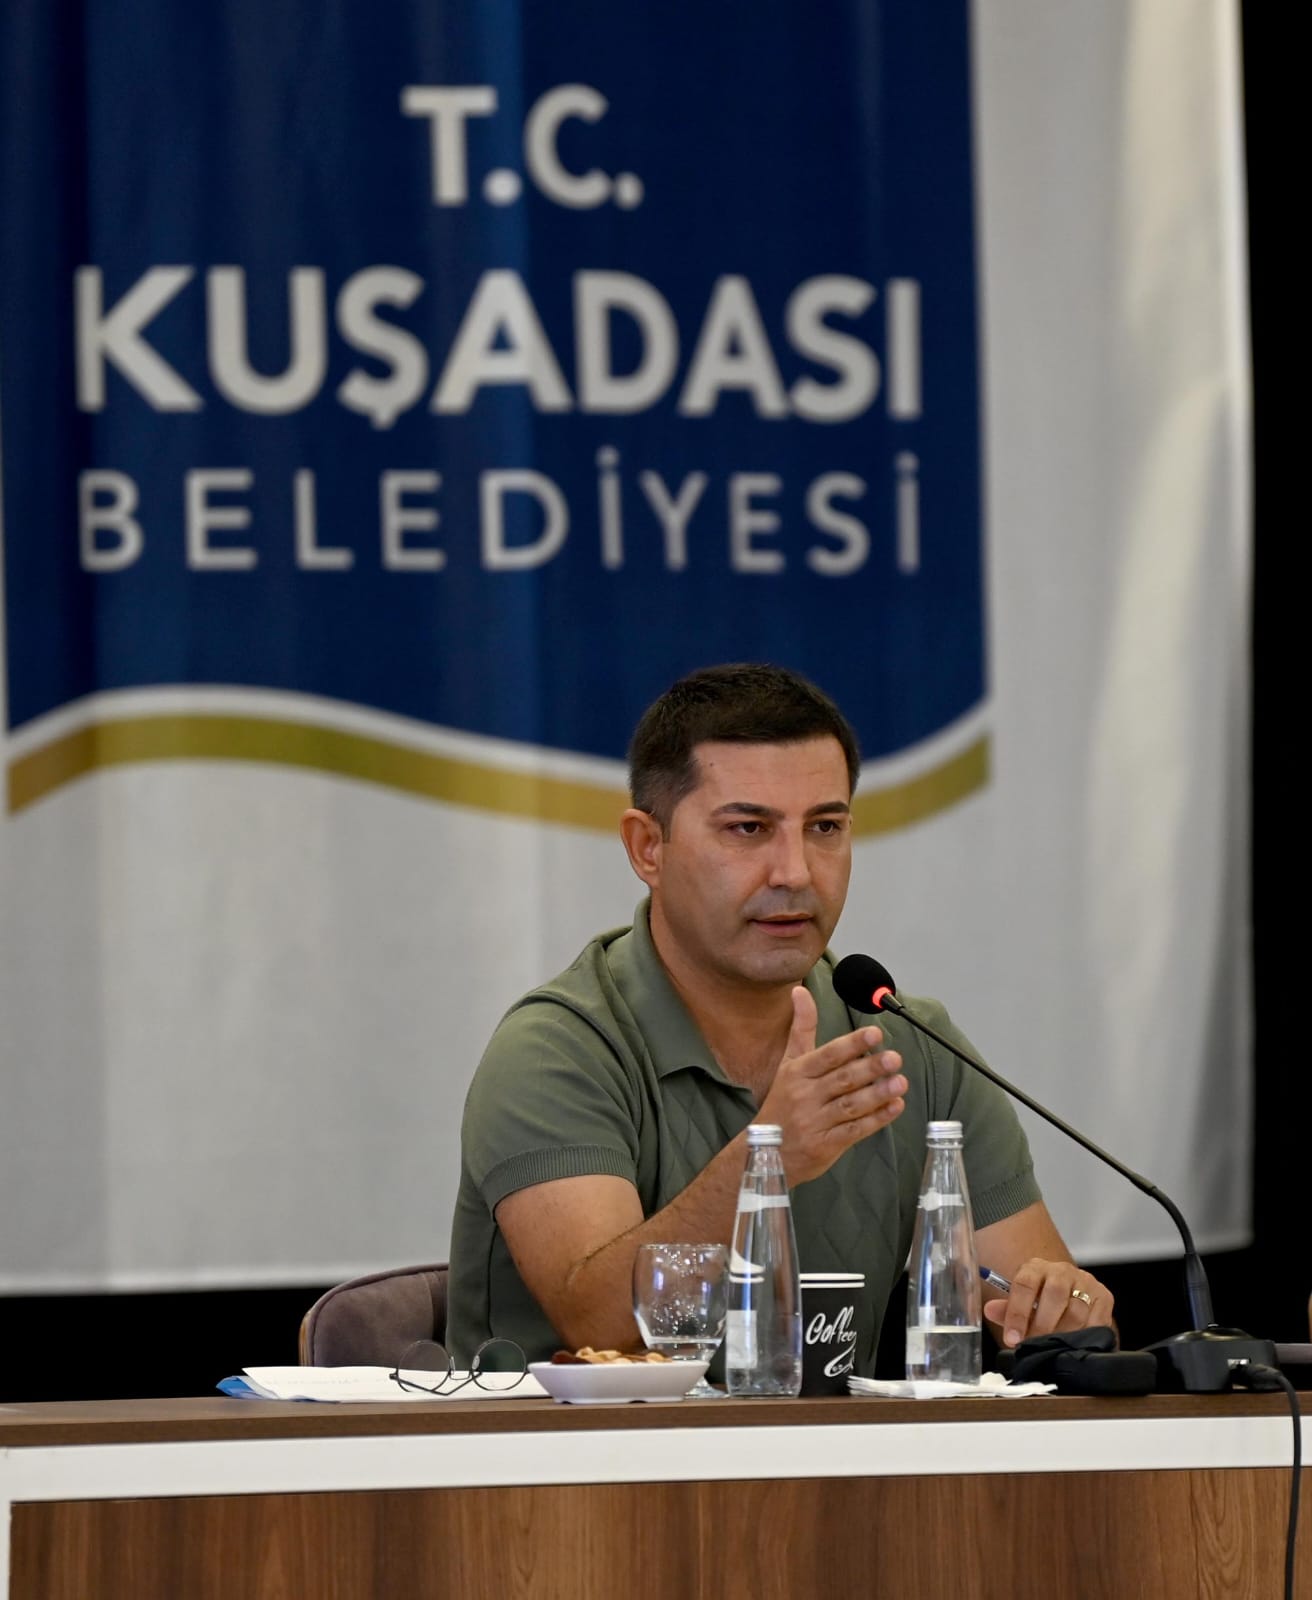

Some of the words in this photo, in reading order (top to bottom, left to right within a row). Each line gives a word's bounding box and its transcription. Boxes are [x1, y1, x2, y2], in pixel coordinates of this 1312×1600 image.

[402, 84, 643, 208] T.C.
[76, 265, 922, 429] KUŞADASI
[80, 447, 920, 575] BELEDİYESİ
